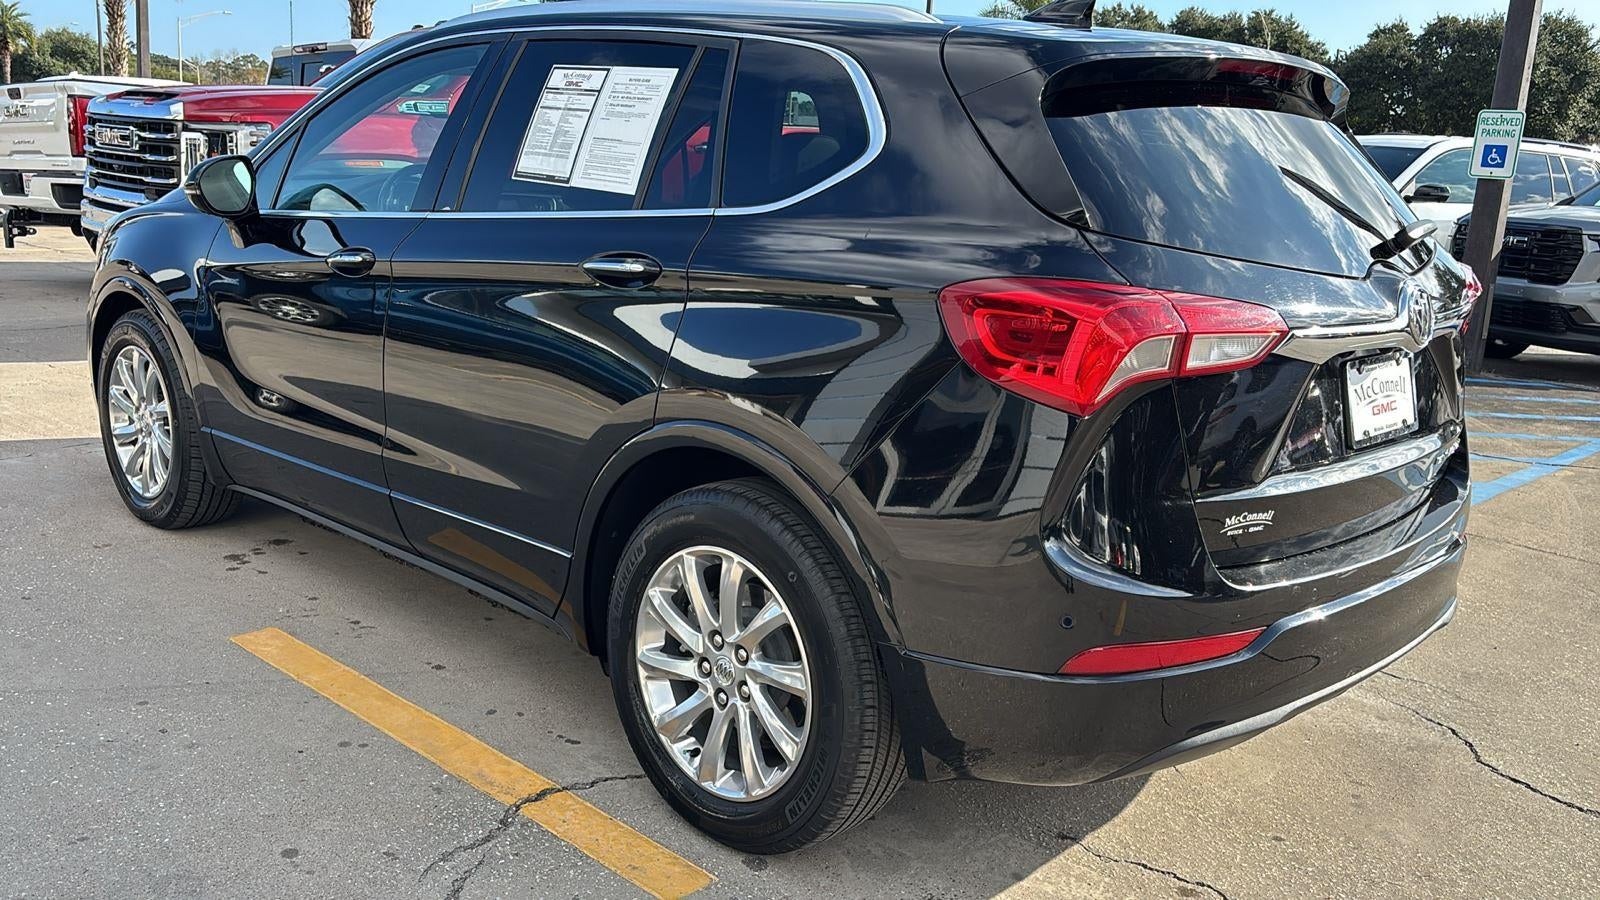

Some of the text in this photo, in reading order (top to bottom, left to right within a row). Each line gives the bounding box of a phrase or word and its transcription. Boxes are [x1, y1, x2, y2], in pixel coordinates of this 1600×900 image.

[564, 80, 584, 88] GMC
[3, 103, 30, 118] GMC
[1480, 116, 1521, 127] RESERVED
[96, 127, 131, 146] GMC
[1480, 128, 1517, 139] PARKING
[1354, 375, 1407, 406] McConnell
[1371, 400, 1398, 417] GMC
[1224, 509, 1275, 528] McConnell
[612, 543, 644, 614] MICHELIN
[787, 746, 829, 821] MICHELIN
